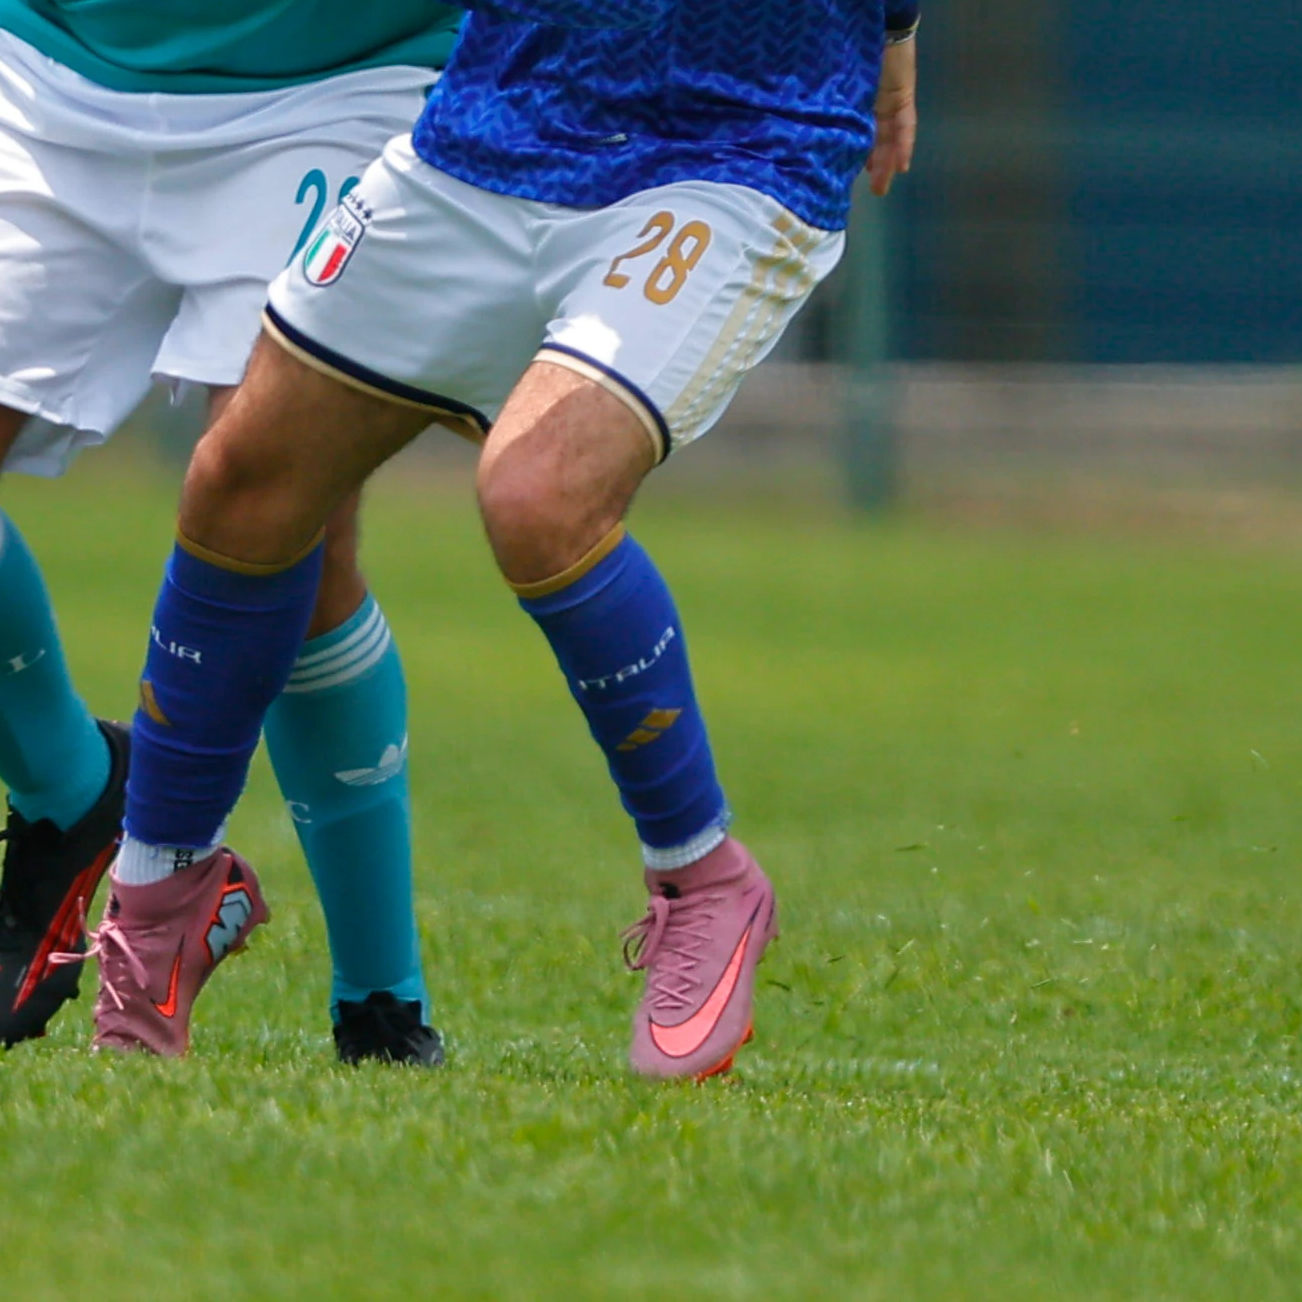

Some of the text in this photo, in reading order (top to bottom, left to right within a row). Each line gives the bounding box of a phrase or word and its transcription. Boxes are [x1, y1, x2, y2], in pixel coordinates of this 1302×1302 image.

[285, 168, 361, 269] 2
[602, 210, 712, 305] 28
[578, 625, 676, 691] ITALIA
